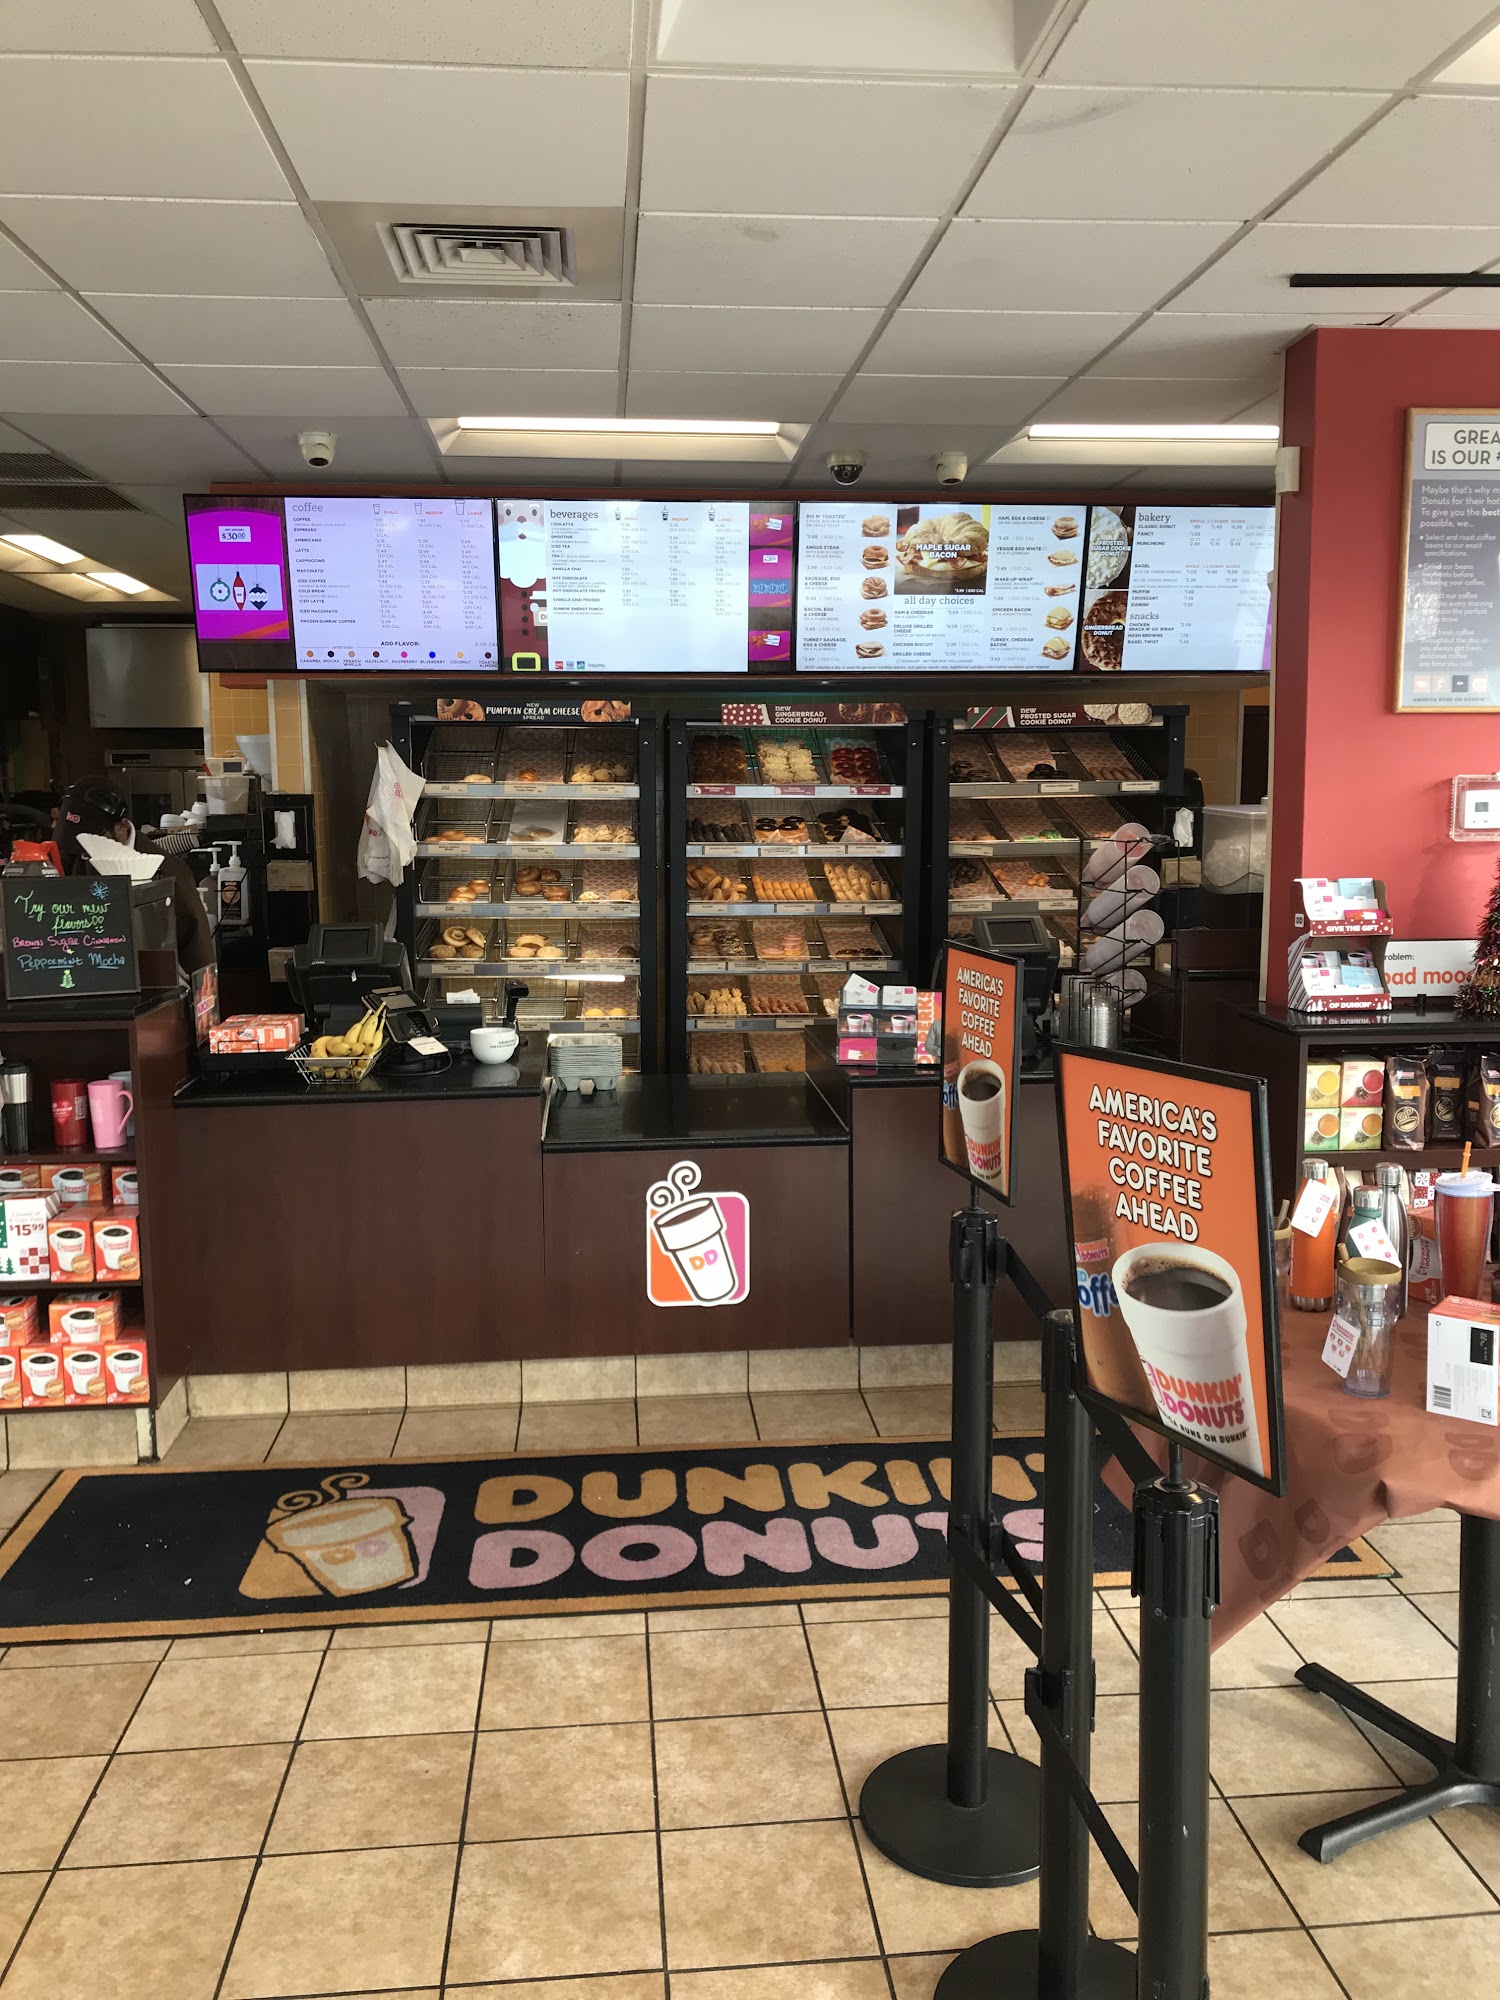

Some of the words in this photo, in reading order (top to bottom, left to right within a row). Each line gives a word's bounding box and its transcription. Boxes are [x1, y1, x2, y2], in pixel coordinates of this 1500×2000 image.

[1431, 449, 1447, 465] IS
[1452, 449, 1491, 465] OUR
[1421, 485, 1450, 495] Maybe
[1451, 485, 1473, 494] that's
[1474, 485, 1491, 496] why
[292, 502, 324, 512] coffee
[1421, 496, 1451, 505] Donuts
[1451, 496, 1464, 505] for
[1465, 496, 1485, 505] their
[550, 509, 599, 522] beverages
[1138, 512, 1171, 524] bakery
[1421, 507, 1431, 516] To
[1431, 508, 1449, 518] give
[1450, 509, 1465, 518] you
[1466, 507, 1480, 516] the
[1481, 507, 1500, 517] best
[1419, 518, 1455, 529] possible,
[1476, 533, 1497, 541] coffee
[943, 543, 972, 551] SUGAR
[1424, 541, 1444, 549] beans
[929, 551, 958, 559] BACON
[1424, 550, 1469, 558] specifications.
[904, 596, 916, 605] all
[918, 596, 937, 607] day
[939, 596, 975, 605] choices
[1129, 612, 1160, 620] snacks
[486, 706, 522, 716] PUMPKIN
[523, 706, 551, 716] CREAM
[552, 707, 581, 716] CHEESE
[774, 705, 792, 713] new
[14, 889, 47, 922] Try
[51, 903, 76, 915] our
[1326, 925, 1345, 933] GIVE
[1361, 924, 1379, 932] GIFT
[87, 952, 126, 966] Mocha
[1383, 952, 1415, 961] roblem:
[956, 965, 1004, 997] AMERICA'S
[1422, 970, 1467, 985] moo
[958, 987, 1001, 1019] FAVORITE
[1329, 1002, 1340, 1010] OF
[1340, 1001, 1372, 1009] DUNKIN'
[960, 1009, 996, 1039] COFFEE
[961, 1031, 993, 1059] AHEAD
[1088, 1084, 1218, 1142] AMERICA'S
[1097, 1119, 1212, 1177] FAVORITE
[971, 1152, 1002, 1172] DONUTS
[1108, 1156, 1203, 1211] COFFEE
[1115, 1192, 1200, 1242] AHEAD
[688, 1248, 719, 1271] DD
[1081, 1248, 1109, 1261] DONUTS
[1154, 1368, 1242, 1405] DUNKIN'
[1162, 1390, 1245, 1430] DONUTS
[1179, 1424, 1202, 1440] RUNS
[1203, 1433, 1217, 1443] ON
[1219, 1430, 1248, 1444] DUNKIN'
